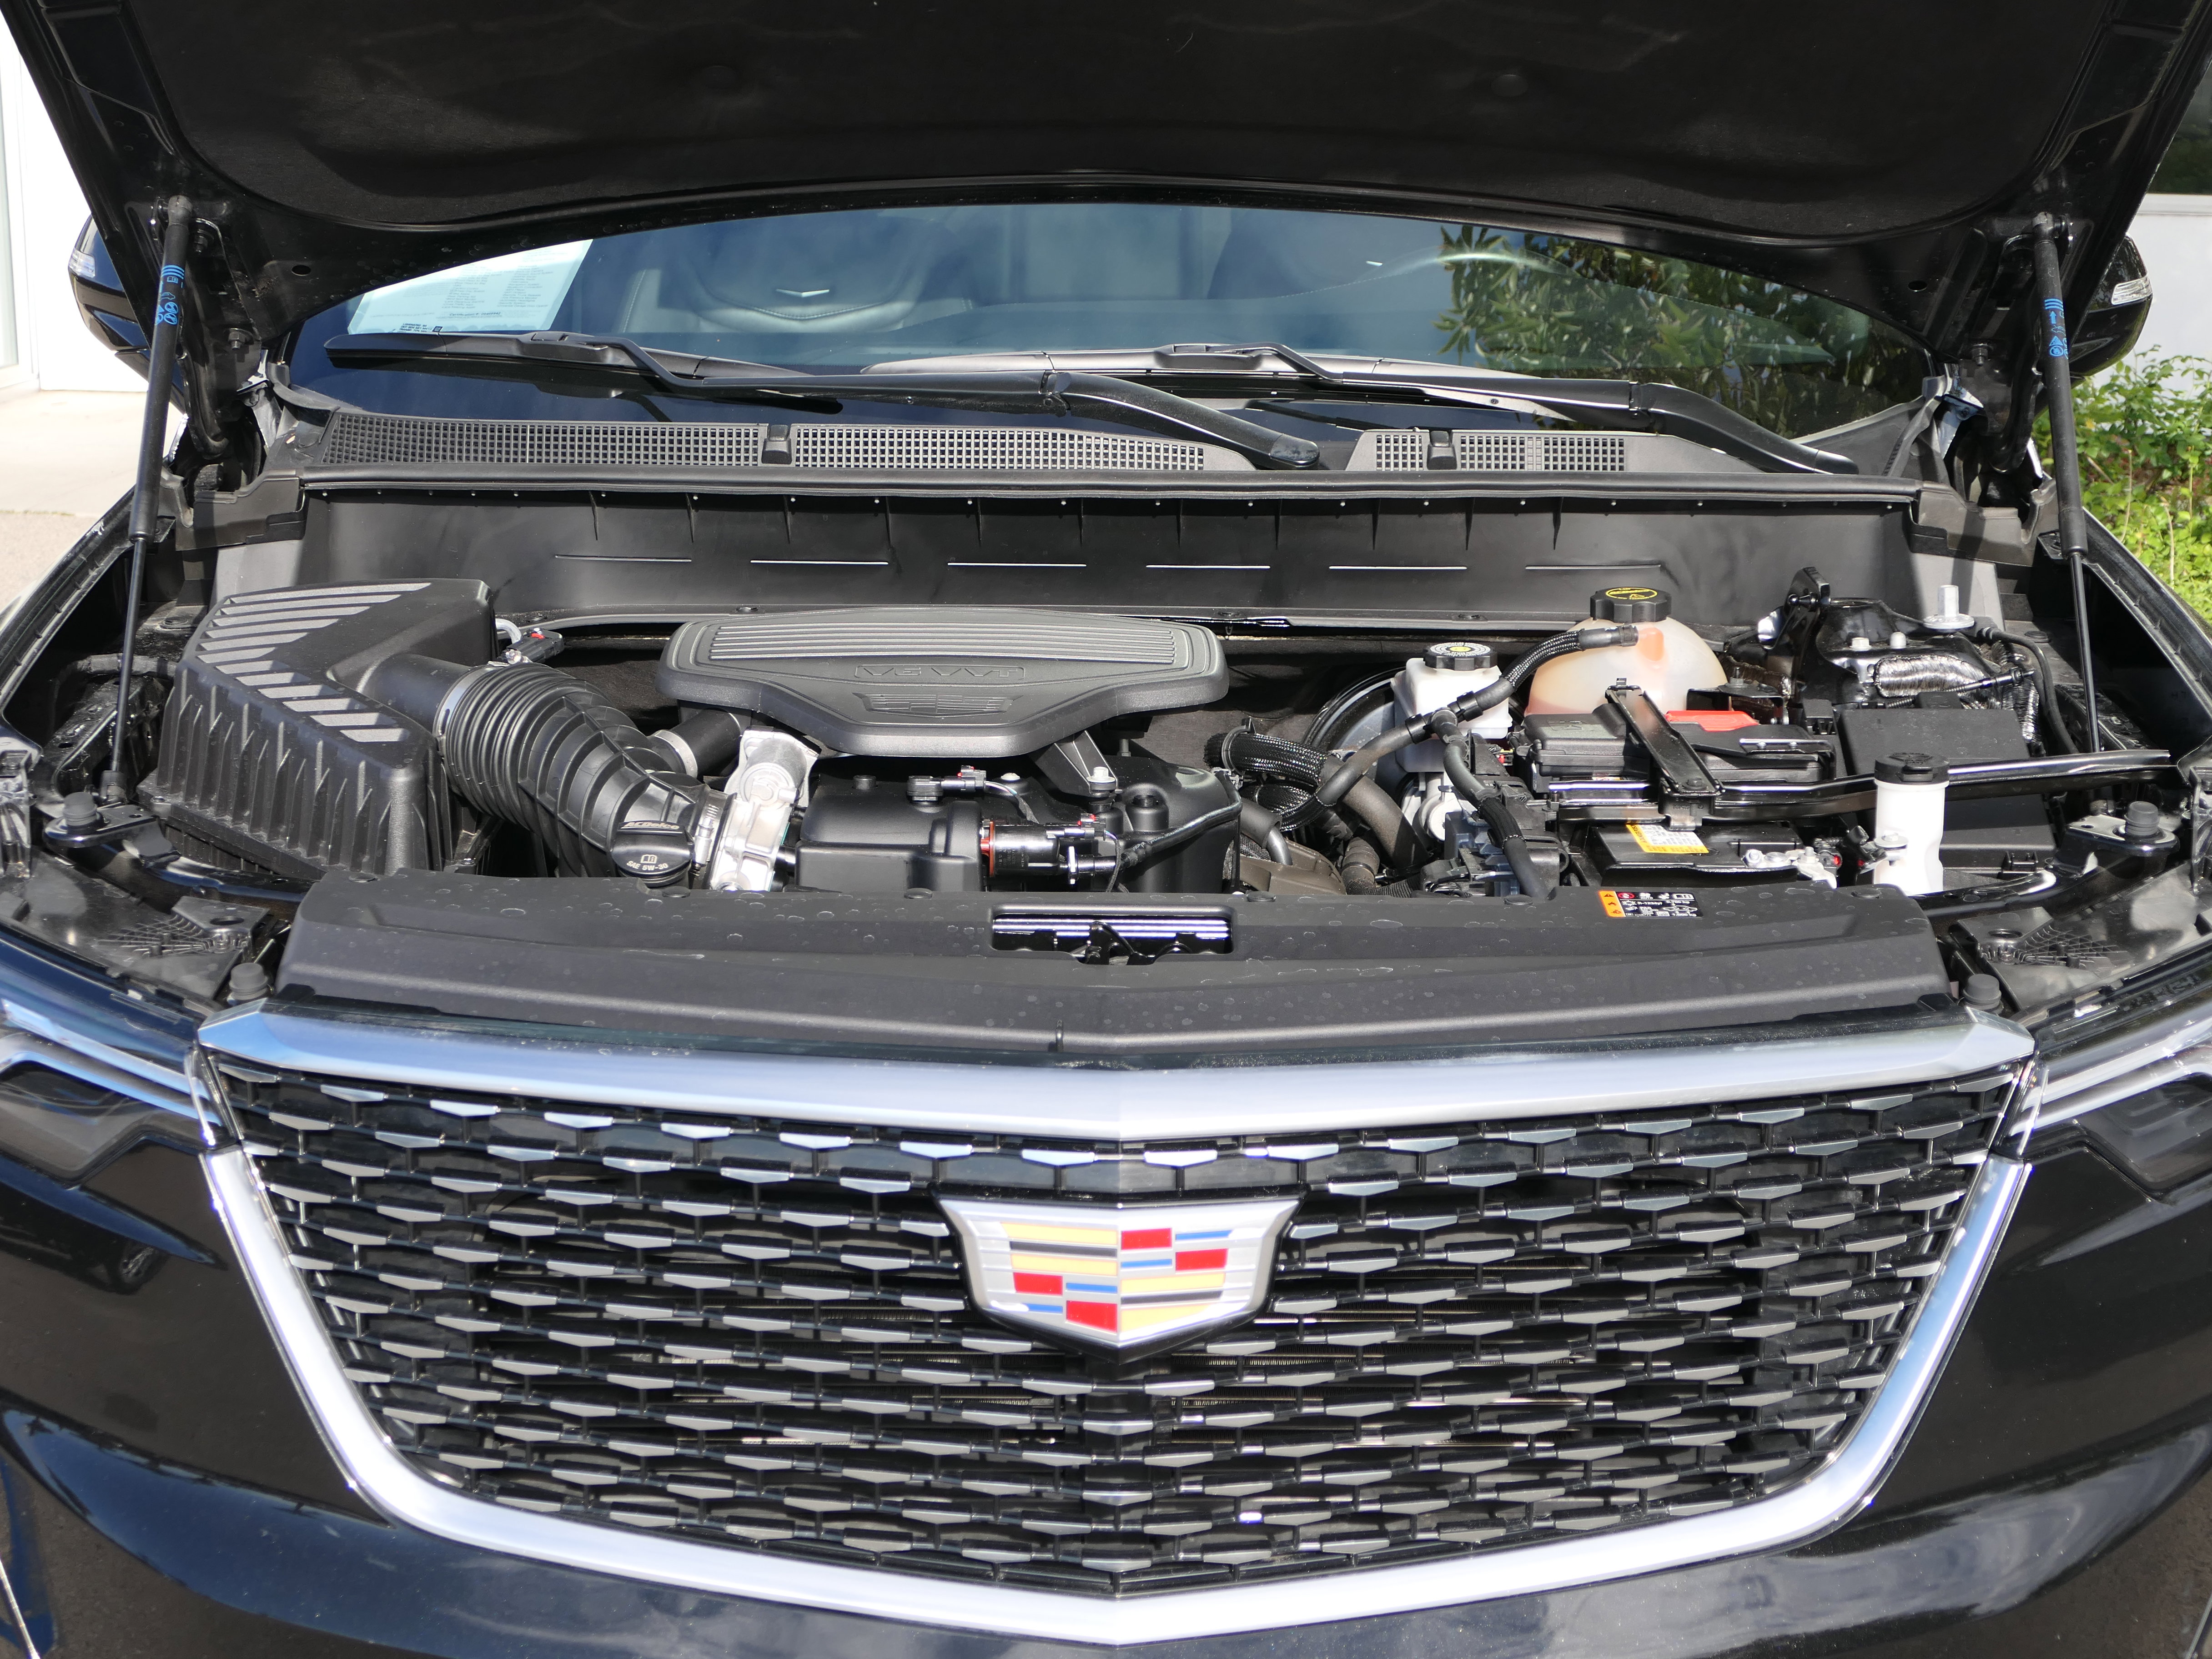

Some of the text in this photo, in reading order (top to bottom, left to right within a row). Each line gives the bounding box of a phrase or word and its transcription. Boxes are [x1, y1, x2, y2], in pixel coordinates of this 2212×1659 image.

[623, 821, 680, 830] ACDelco
[627, 860, 669, 871] SAE 5W-30
